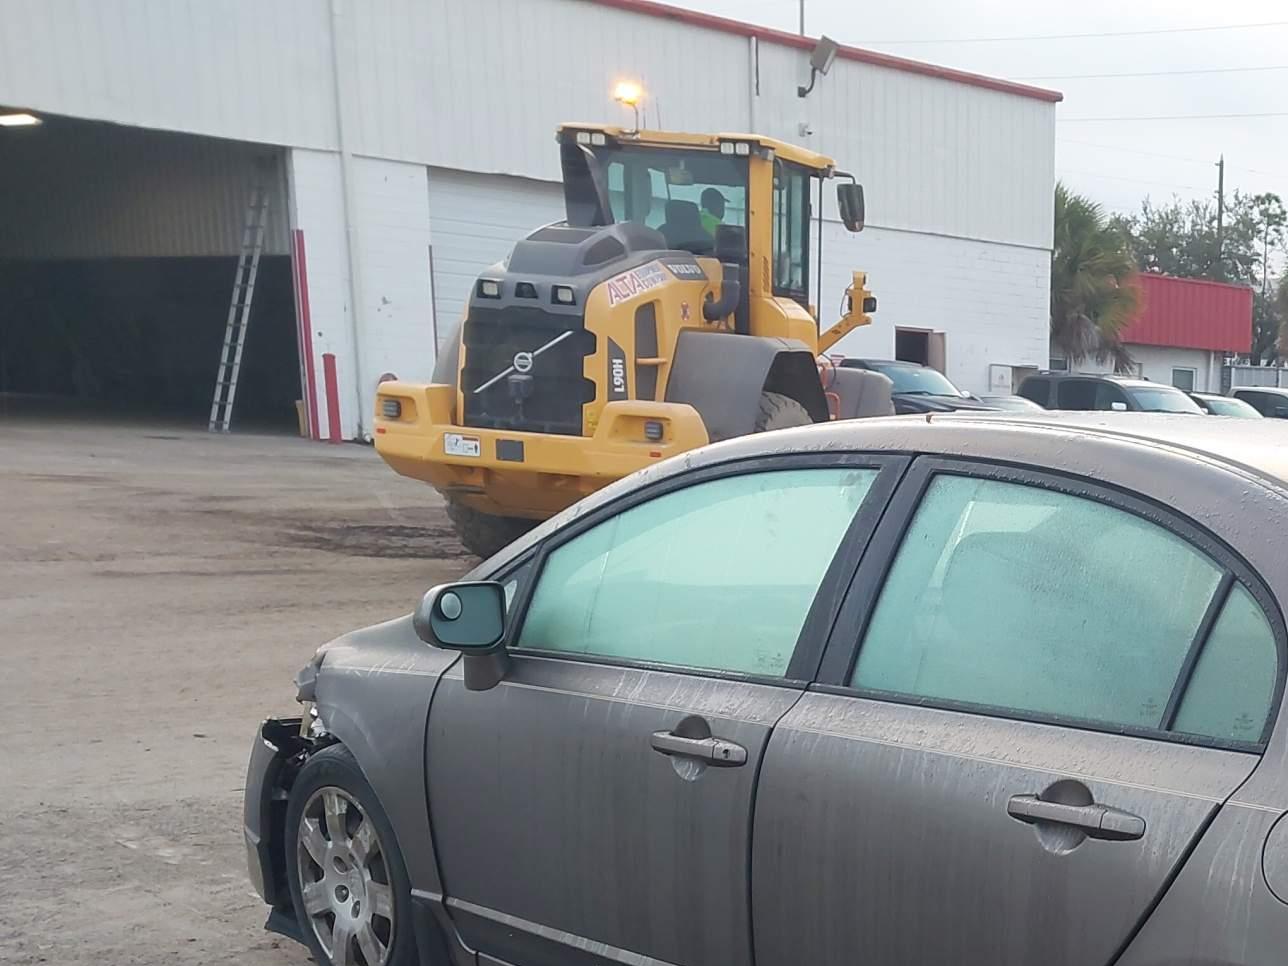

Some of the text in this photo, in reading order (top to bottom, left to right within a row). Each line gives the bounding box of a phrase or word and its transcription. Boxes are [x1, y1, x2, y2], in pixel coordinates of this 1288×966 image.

[667, 263, 701, 275] VOLVO
[607, 269, 643, 305] ALTA
[612, 359, 625, 392] L90H
